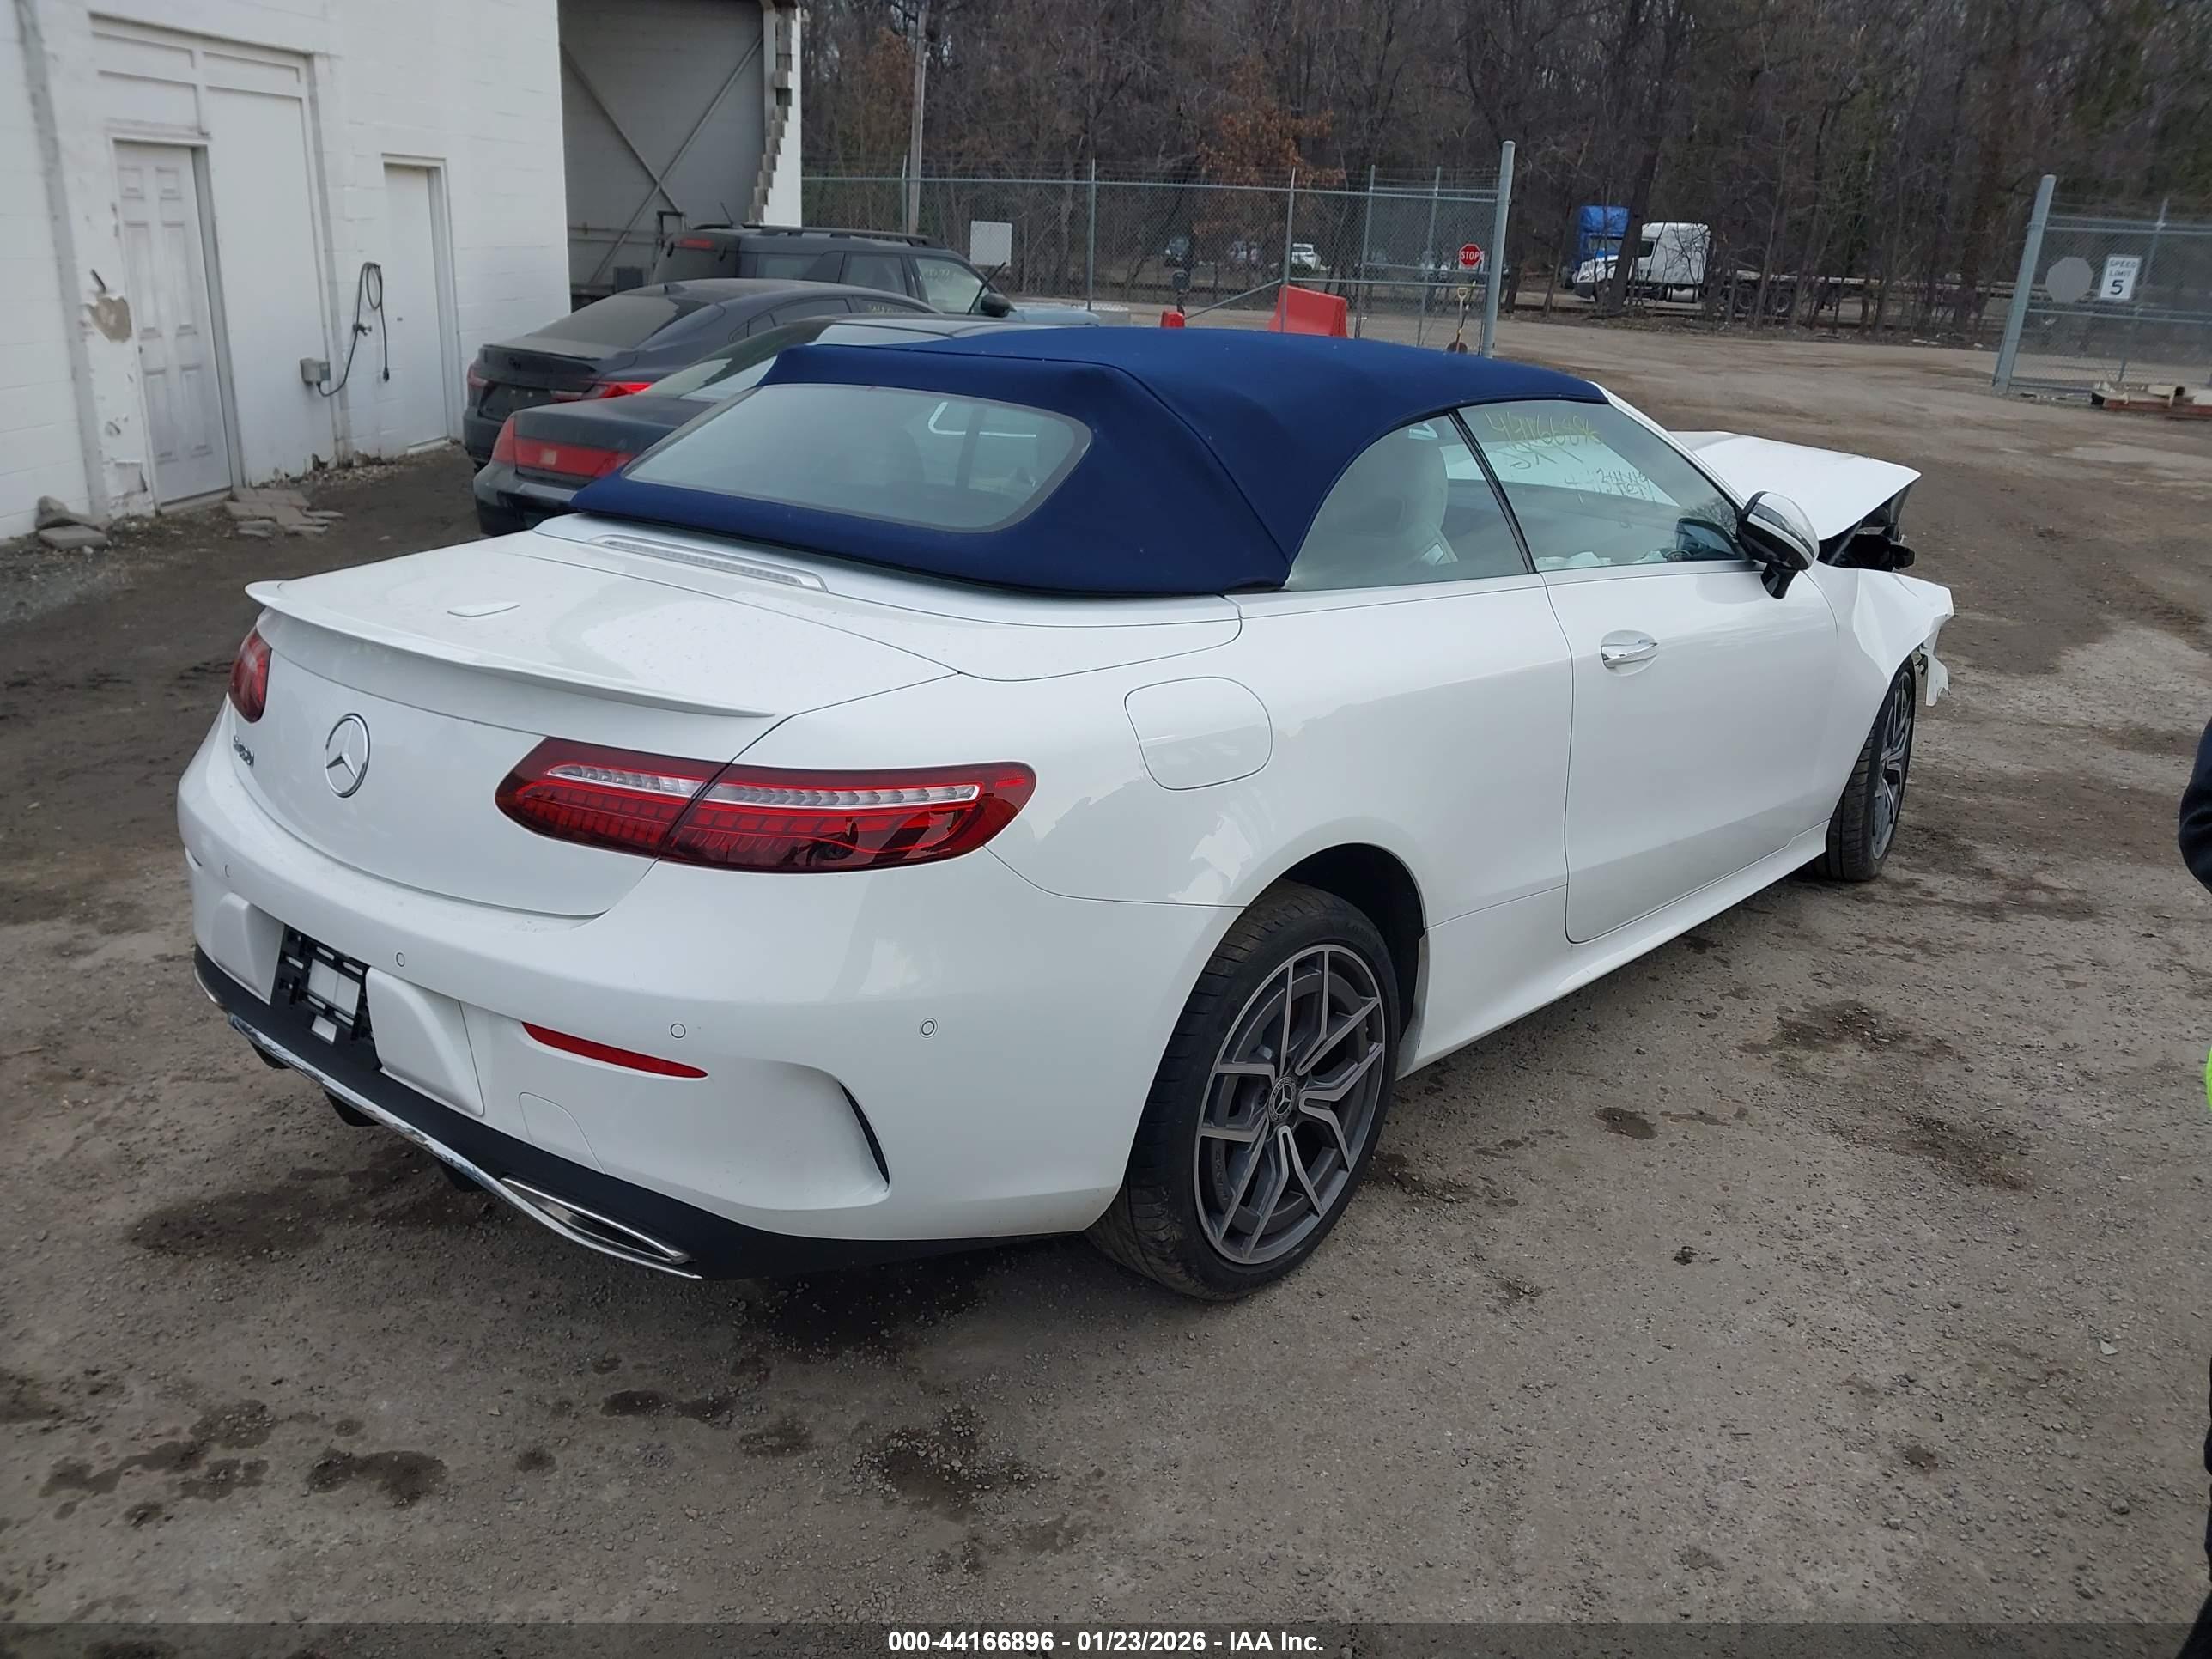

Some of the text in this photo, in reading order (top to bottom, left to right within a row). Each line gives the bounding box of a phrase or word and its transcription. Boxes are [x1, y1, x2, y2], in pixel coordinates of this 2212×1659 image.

[1461, 251, 1480, 260] STOP
[2109, 260, 2137, 269] SPEED
[2110, 280, 2124, 295] 5
